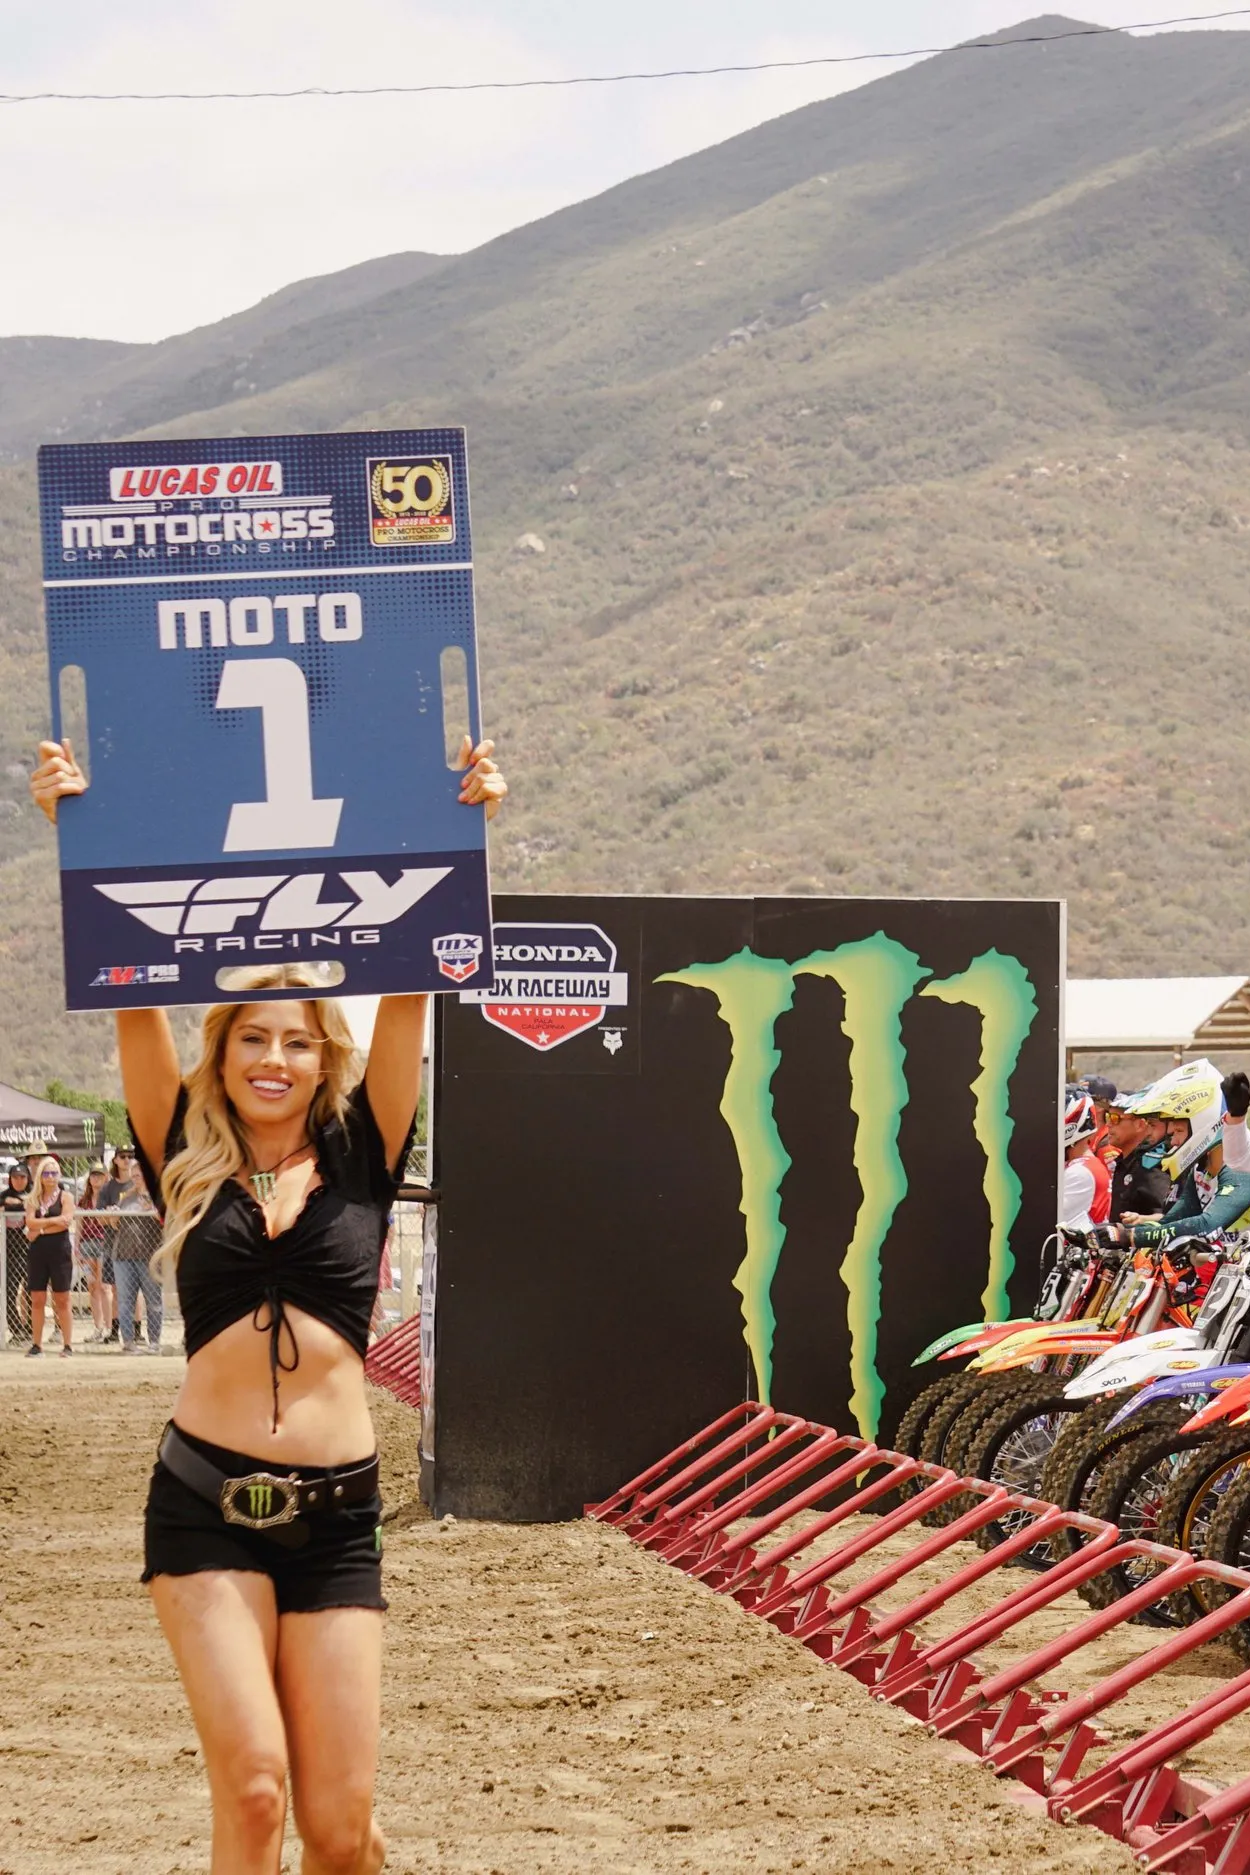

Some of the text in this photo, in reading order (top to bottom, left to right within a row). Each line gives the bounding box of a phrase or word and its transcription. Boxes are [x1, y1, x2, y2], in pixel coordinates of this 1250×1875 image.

[119, 464, 277, 498] LUCAS OIL
[383, 465, 443, 513] 50
[160, 498, 235, 513] PRO
[61, 508, 335, 549] MOTOCROSS
[377, 526, 450, 536] PRO MOTOCROSS
[395, 518, 418, 526] LUCAS
[62, 538, 337, 563] CHAMPIONSHIP
[158, 592, 364, 649] MOTO
[214, 656, 345, 853] 1
[92, 865, 455, 935] FLY
[173, 928, 382, 955] RACING
[494, 945, 607, 962] HONDA
[477, 978, 611, 999] OX RACEWAY
[497, 1007, 591, 1017] NATIONAL
[521, 1023, 566, 1031] CALIFORNIA
[1172, 1094, 1198, 1114] TWISTED
